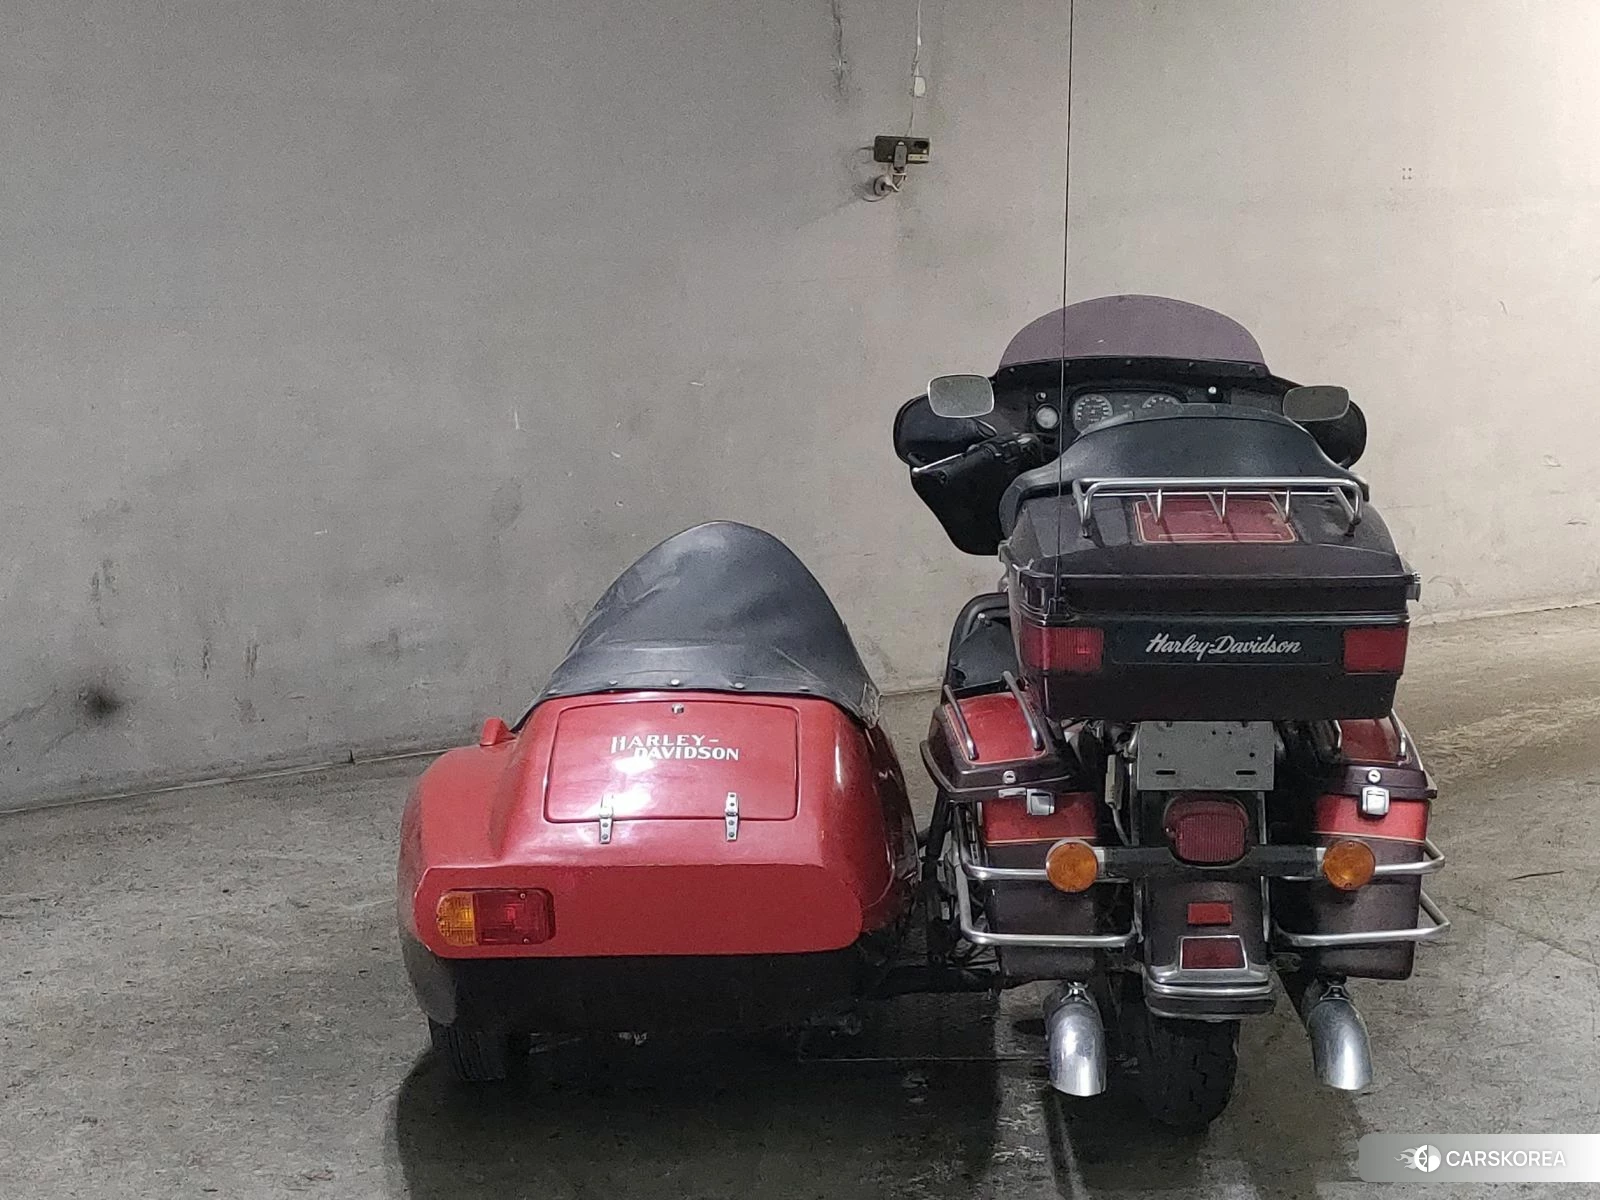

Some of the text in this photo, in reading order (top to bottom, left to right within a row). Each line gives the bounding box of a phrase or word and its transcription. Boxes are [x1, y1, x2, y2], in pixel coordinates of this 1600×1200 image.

[1145, 632, 1302, 661] Harley-Davidson
[611, 734, 719, 754] HARLEY-
[633, 746, 739, 761] DAVIDSON
